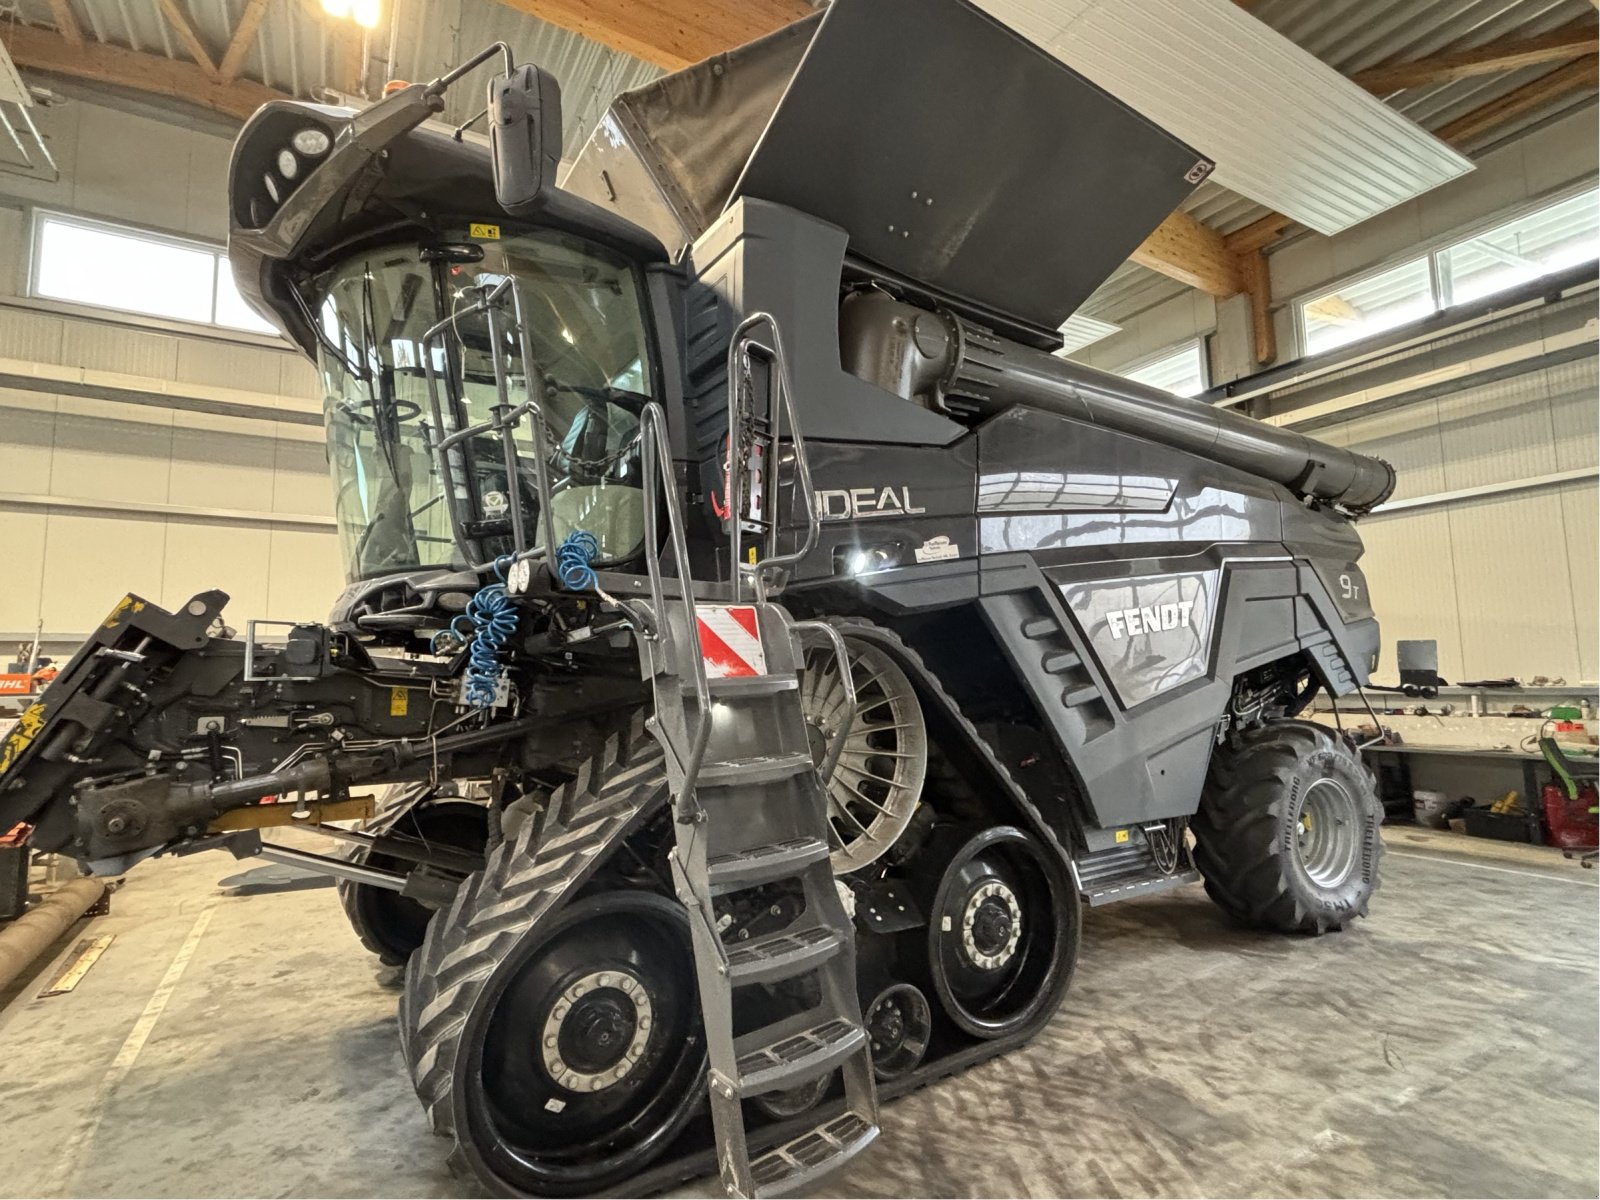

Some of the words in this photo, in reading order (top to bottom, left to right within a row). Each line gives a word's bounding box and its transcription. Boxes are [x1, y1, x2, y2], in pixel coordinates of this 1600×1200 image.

[815, 486, 926, 521] IDEAL
[1340, 574, 1360, 599] 9T
[1105, 600, 1194, 639] FENDT
